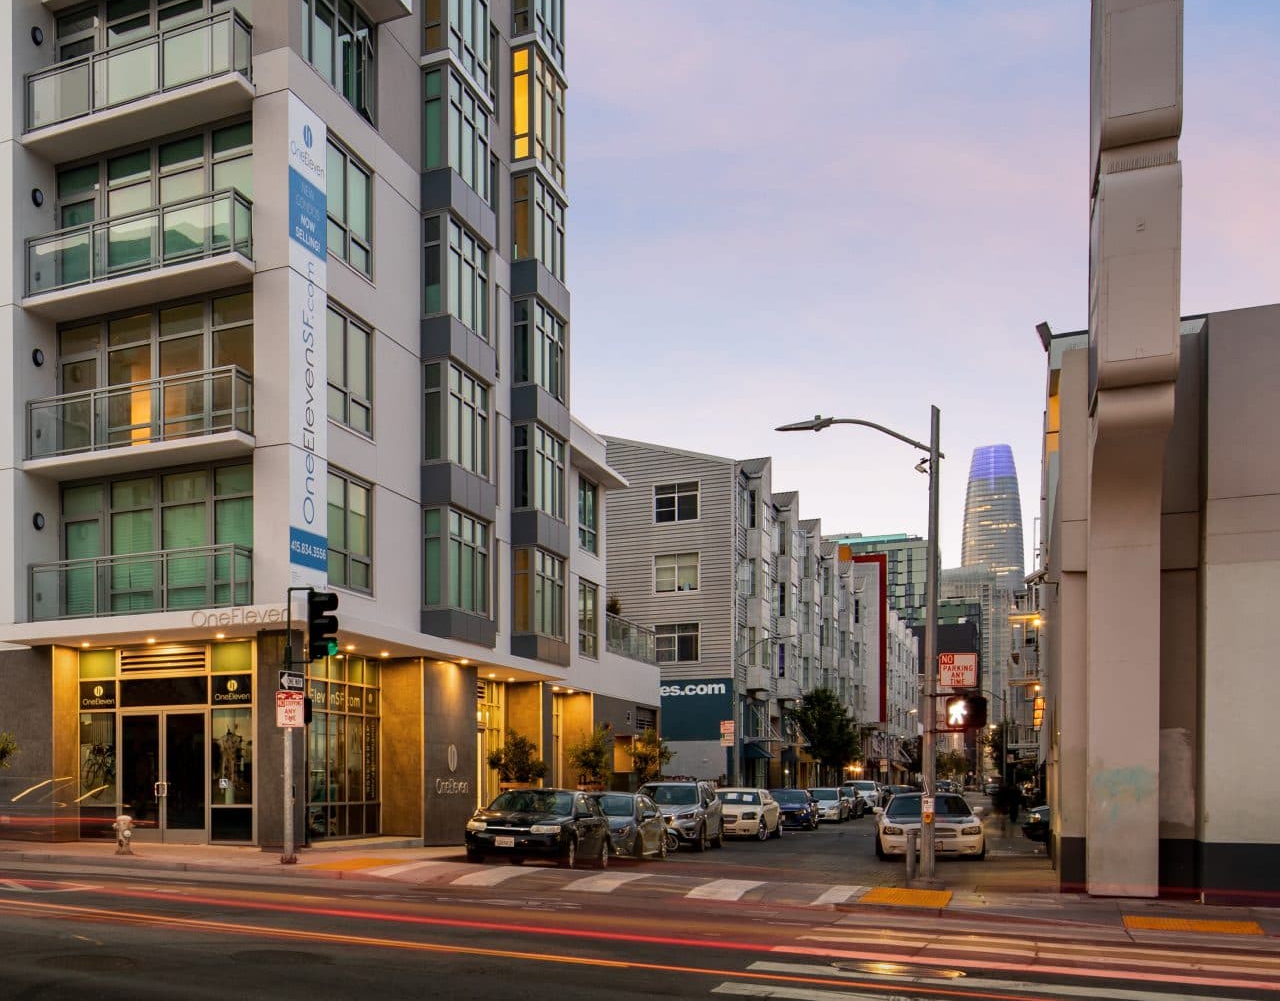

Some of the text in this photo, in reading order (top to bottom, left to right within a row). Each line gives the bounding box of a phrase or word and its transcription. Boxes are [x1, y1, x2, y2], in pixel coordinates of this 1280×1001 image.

[300, 214, 316, 233] NOW
[303, 261, 315, 524] OneElevenSF.com
[941, 655, 954, 664] NO
[660, 683, 726, 696] es.com
[83, 698, 115, 706] OneEleven
[215, 692, 251, 701] OneEleven
[435, 778, 469, 795] OneEleven
